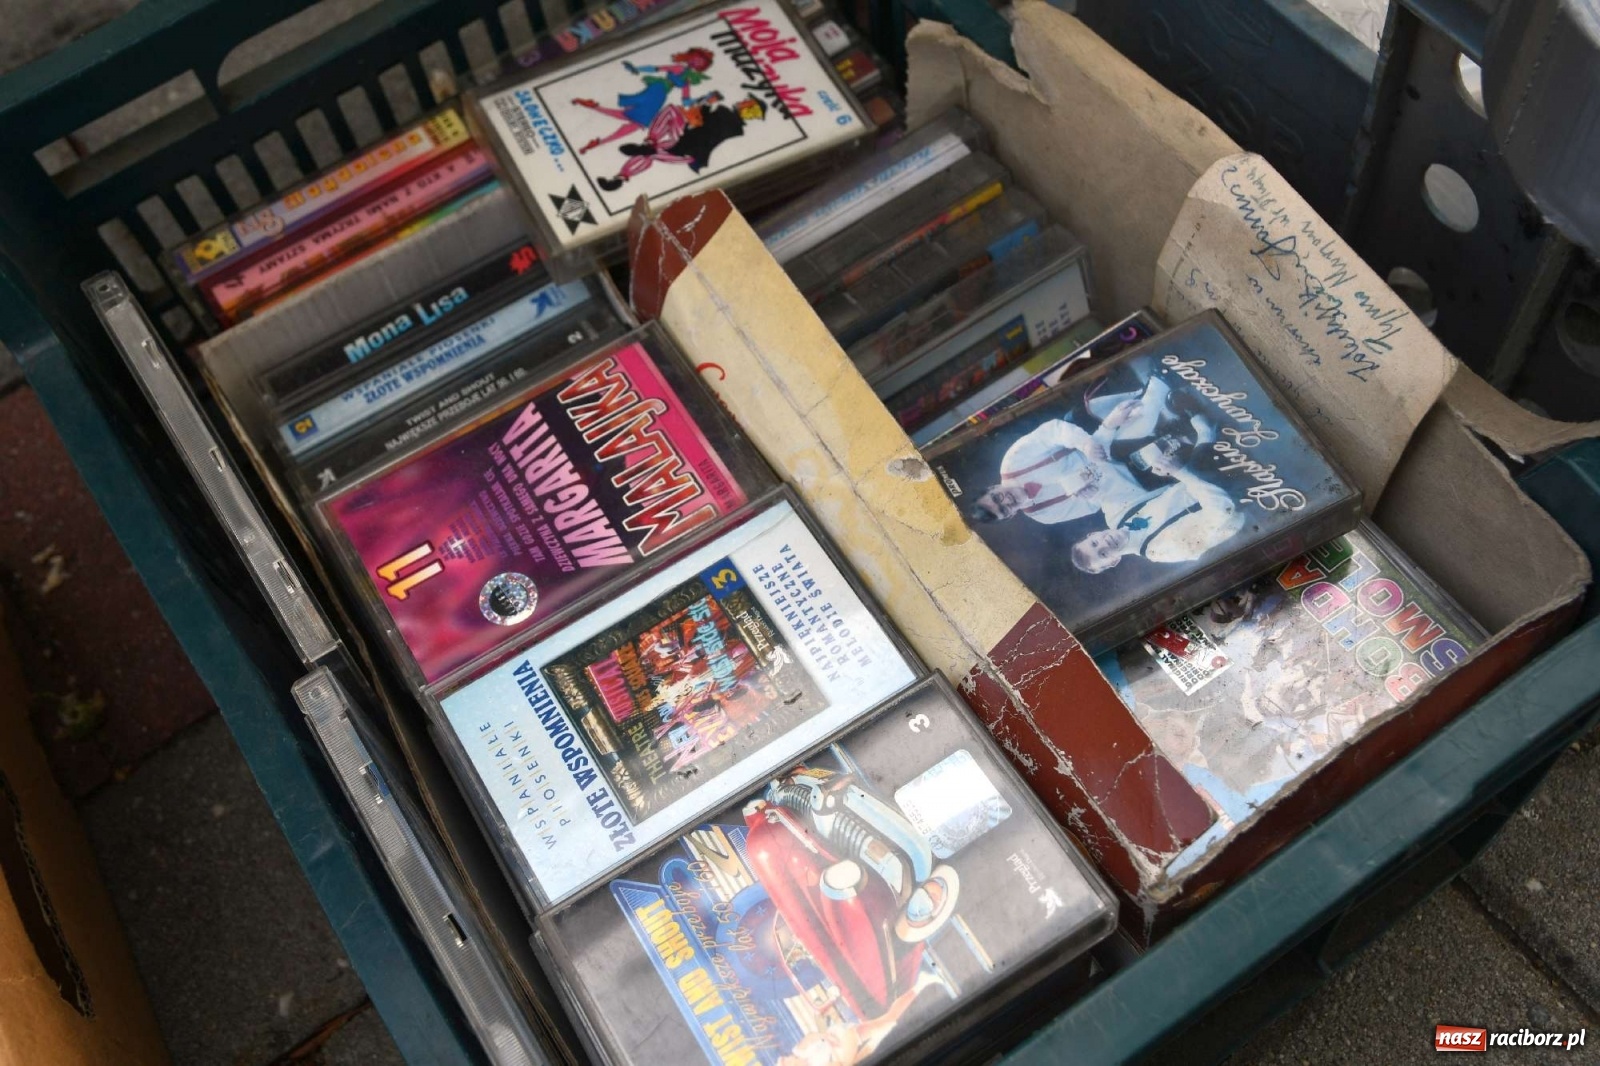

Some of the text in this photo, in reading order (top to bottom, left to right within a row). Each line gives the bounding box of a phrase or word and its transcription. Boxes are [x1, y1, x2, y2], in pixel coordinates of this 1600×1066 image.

[717, 3, 800, 65] Moja
[711, 28, 814, 121] muzyka
[834, 113, 852, 126] 6
[343, 322, 414, 364] Mona
[401, 332, 485, 384] WSPOMNIENIA
[428, 316, 495, 356] PIOSENKI
[404, 371, 495, 427] TWIST AND SHOUT
[436, 391, 482, 422] PRZEBOJE
[1159, 351, 1280, 449] Zwyczaje
[487, 441, 506, 465] NOCY
[500, 463, 518, 482] DNA
[556, 356, 717, 556] MALAJKA
[1212, 437, 1307, 509] Śląskie
[500, 401, 632, 569] MARGARITA
[512, 482, 538, 515] SAMEGO
[698, 457, 736, 509] MARGARITA
[515, 522, 534, 545] GDZIE
[528, 544, 546, 563] TAM
[536, 523, 574, 573] DZIEWCZYNA
[376, 541, 446, 603] 11
[709, 564, 738, 591] 3
[735, 610, 769, 651] Przegląd
[751, 563, 840, 682] NAJPIĘKNIEJSZE
[770, 561, 849, 665] ROMANTYCZNE
[777, 543, 872, 668] MELODIE ŚWIATA
[614, 640, 647, 690] SQUARE
[1160, 654, 1192, 688] ORIGINAL
[908, 712, 931, 734] 3
[502, 718, 572, 827] PIOSENKI
[510, 659, 636, 851] ZŁOTE WSPOMNIENIA
[625, 721, 667, 784] THEATRE
[477, 720, 559, 850] WSPANIAŁE
[634, 897, 695, 970] SHOUT
[666, 881, 729, 949] przeboje
[728, 925, 756, 950] lat
[676, 966, 723, 1016] AND
